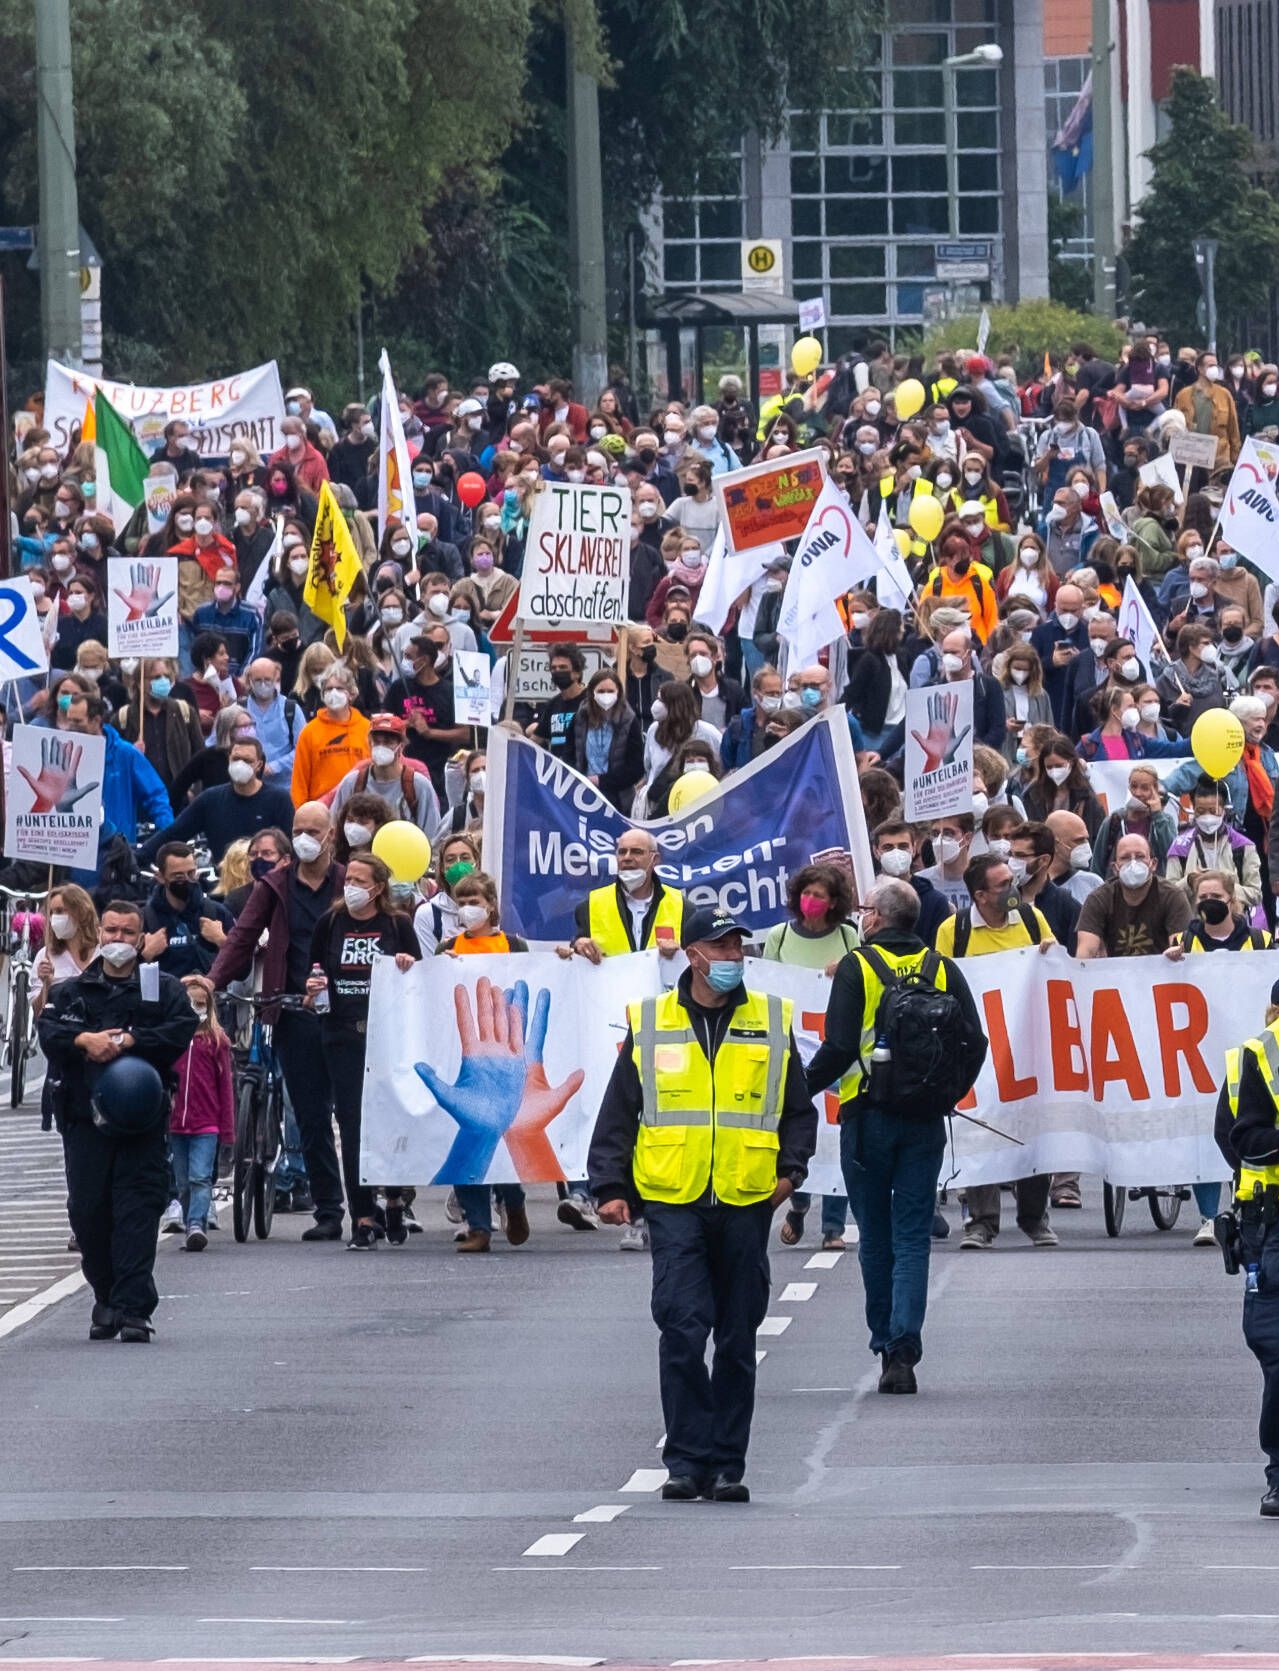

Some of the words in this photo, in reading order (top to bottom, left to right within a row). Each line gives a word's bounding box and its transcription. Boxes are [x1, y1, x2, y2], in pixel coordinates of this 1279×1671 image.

[191, 416, 275, 452] SELLSCHAFT
[552, 488, 628, 533] TIER-
[538, 531, 623, 578] SKLAVEREI
[530, 577, 625, 621] abschaffen!
[520, 658, 550, 673] Stra
[913, 759, 969, 792] #UNTEILBAR
[534, 749, 714, 851] Woen
[16, 815, 93, 829] #UNTEILBAR
[578, 816, 617, 851] is
[529, 830, 786, 882] Menchen-
[343, 937, 381, 953] FCK
